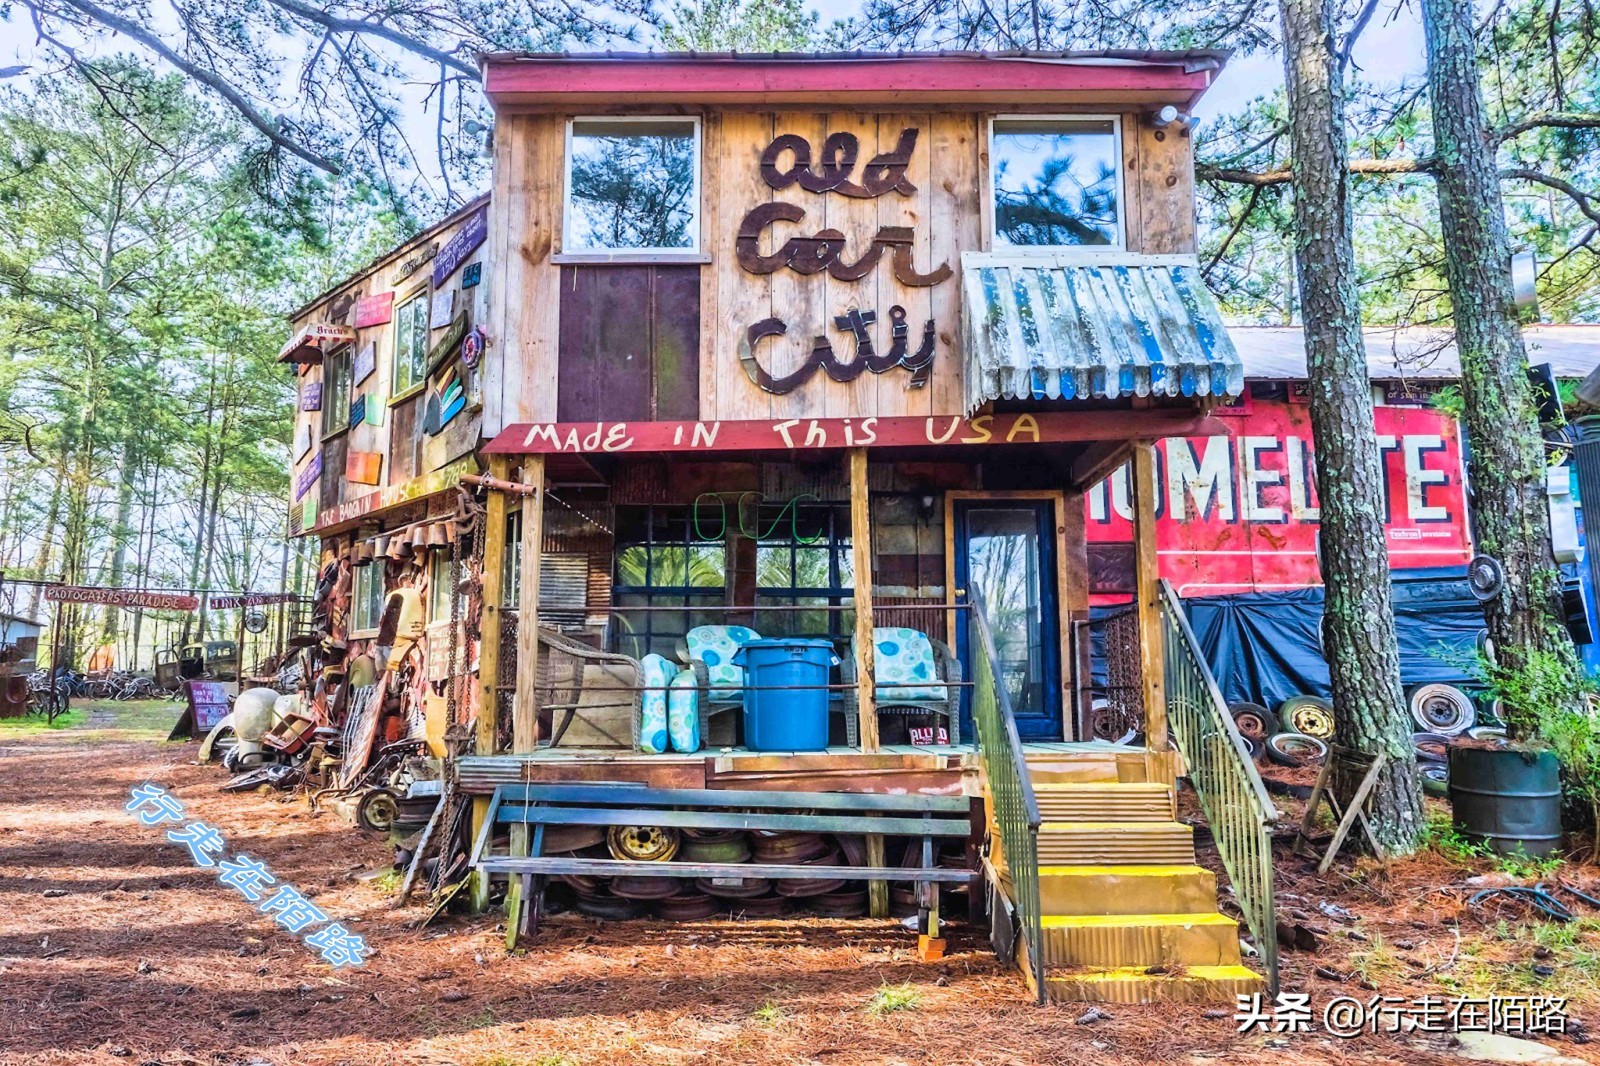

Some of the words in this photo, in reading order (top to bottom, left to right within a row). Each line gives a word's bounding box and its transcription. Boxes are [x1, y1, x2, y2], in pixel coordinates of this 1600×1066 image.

[736, 202, 953, 287] Car
[738, 305, 936, 395] City
[673, 421, 719, 447] IN
[925, 413, 1041, 445] USA
[339, 494, 372, 524] BARGAIN
[127, 594, 179, 609] PARADISE
